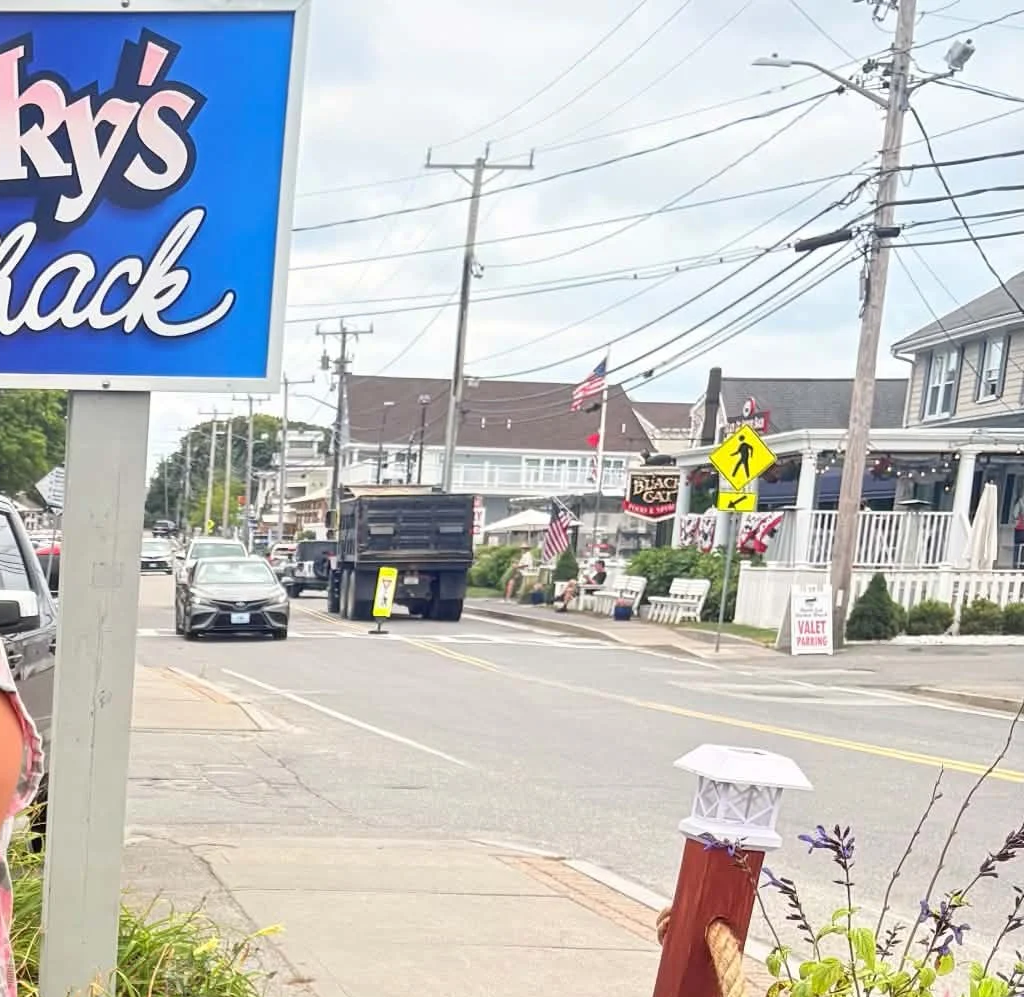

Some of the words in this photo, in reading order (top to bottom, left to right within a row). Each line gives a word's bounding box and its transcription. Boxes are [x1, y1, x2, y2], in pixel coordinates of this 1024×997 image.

[642, 489, 678, 503] CAT
[798, 620, 827, 634] VALET
[796, 636, 828, 648] PARKING
